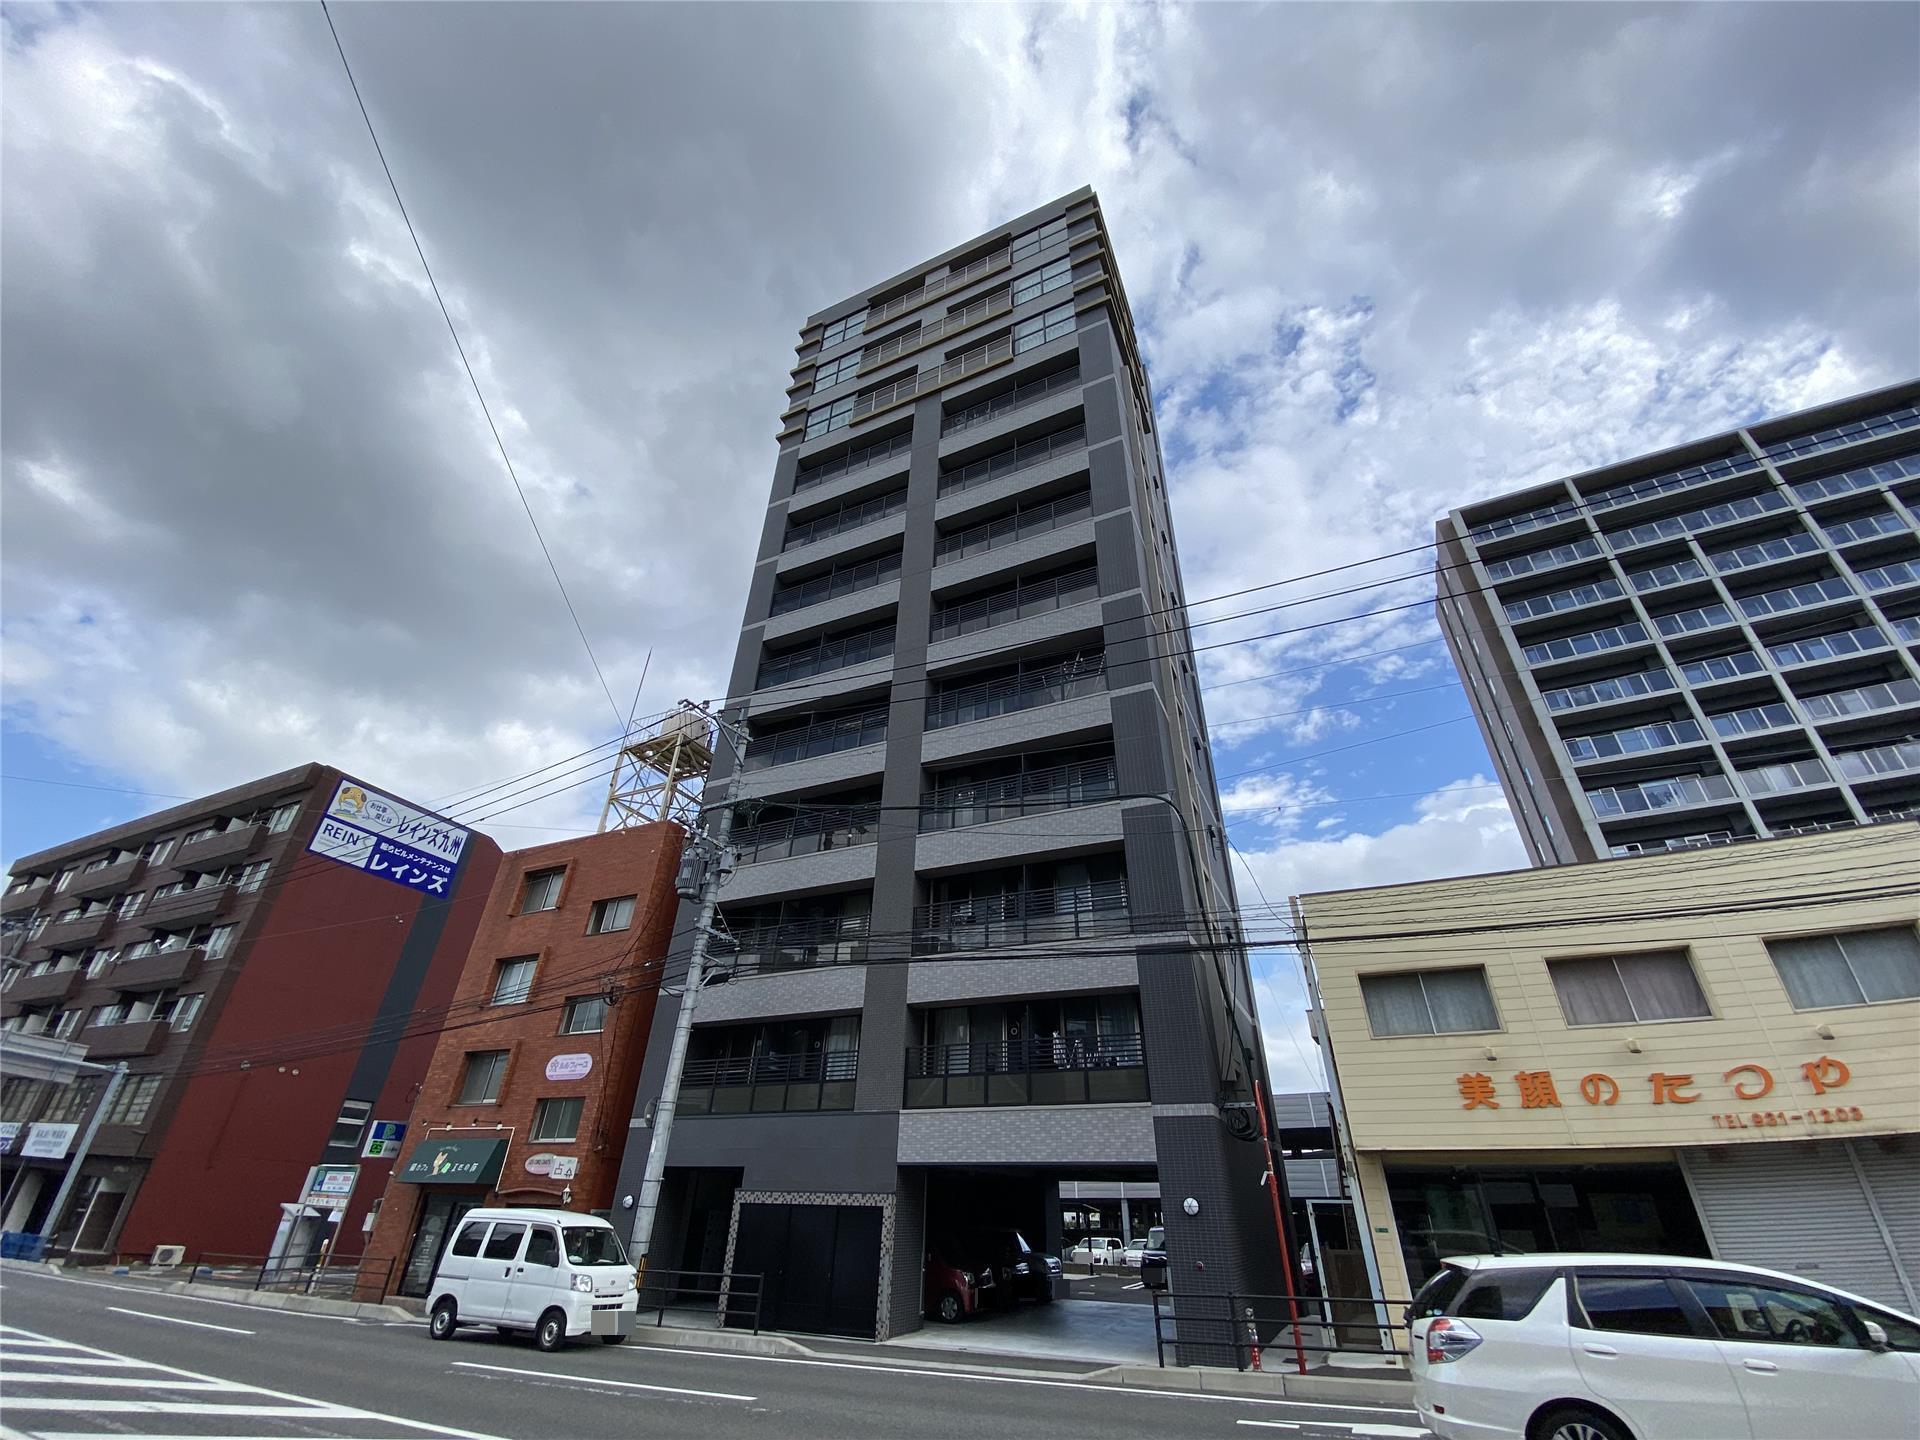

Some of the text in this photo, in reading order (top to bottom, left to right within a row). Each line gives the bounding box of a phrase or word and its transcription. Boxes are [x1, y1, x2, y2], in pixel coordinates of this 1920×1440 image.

[397, 815, 463, 857] レインズ九州
[369, 854, 448, 893] レインズ
[380, 842, 452, 874] 総合ビルメンテナンスは
[1457, 1055, 1852, 1110] 美顔のたつや
[1712, 1114, 1747, 1129] TEL
